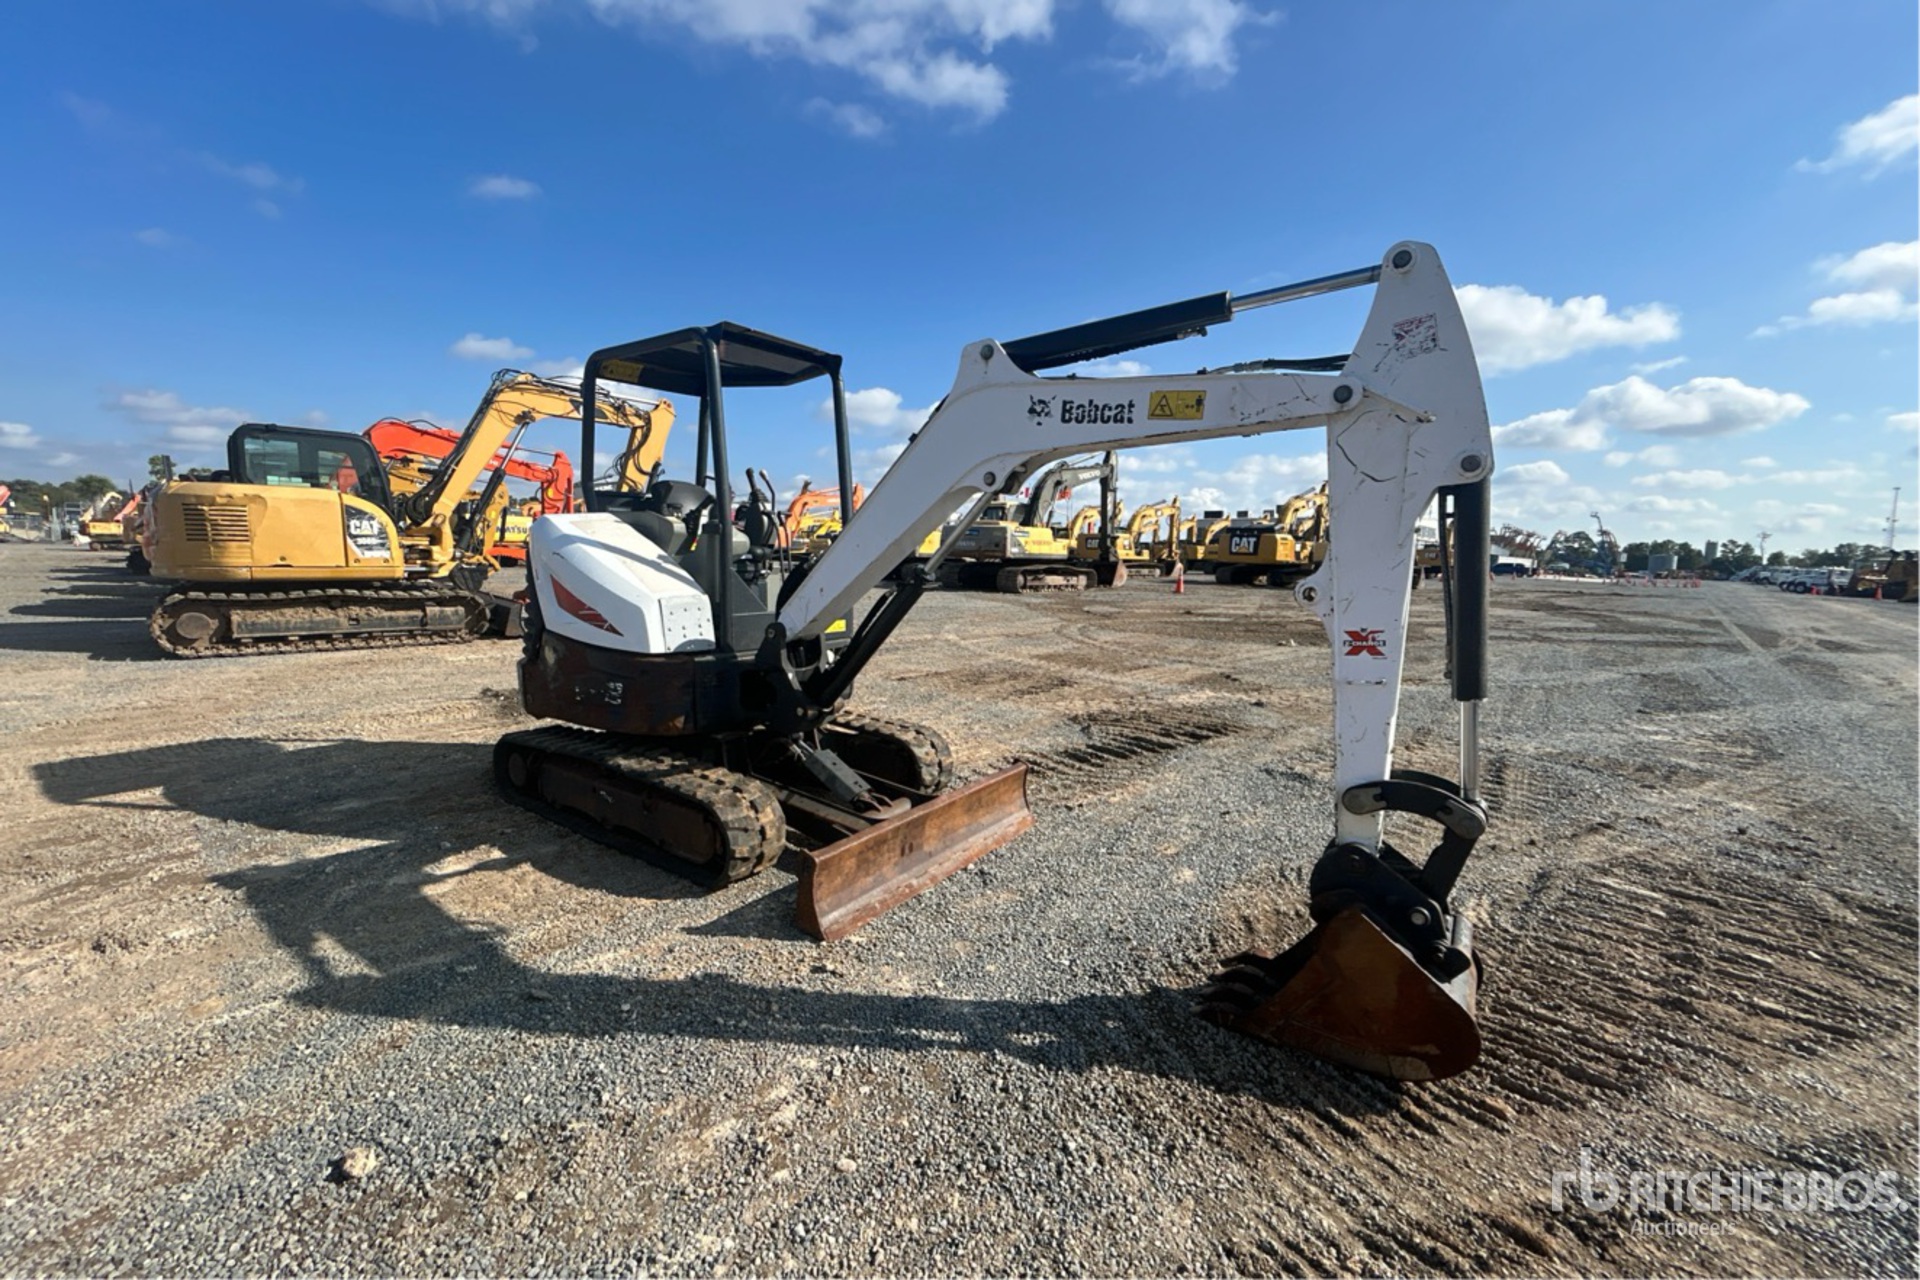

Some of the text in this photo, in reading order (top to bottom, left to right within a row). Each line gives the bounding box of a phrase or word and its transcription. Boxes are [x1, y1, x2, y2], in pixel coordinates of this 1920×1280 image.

[1060, 399, 1135, 424] Bobcat
[349, 519, 380, 535] CAT
[1231, 536, 1258, 553] CAT
